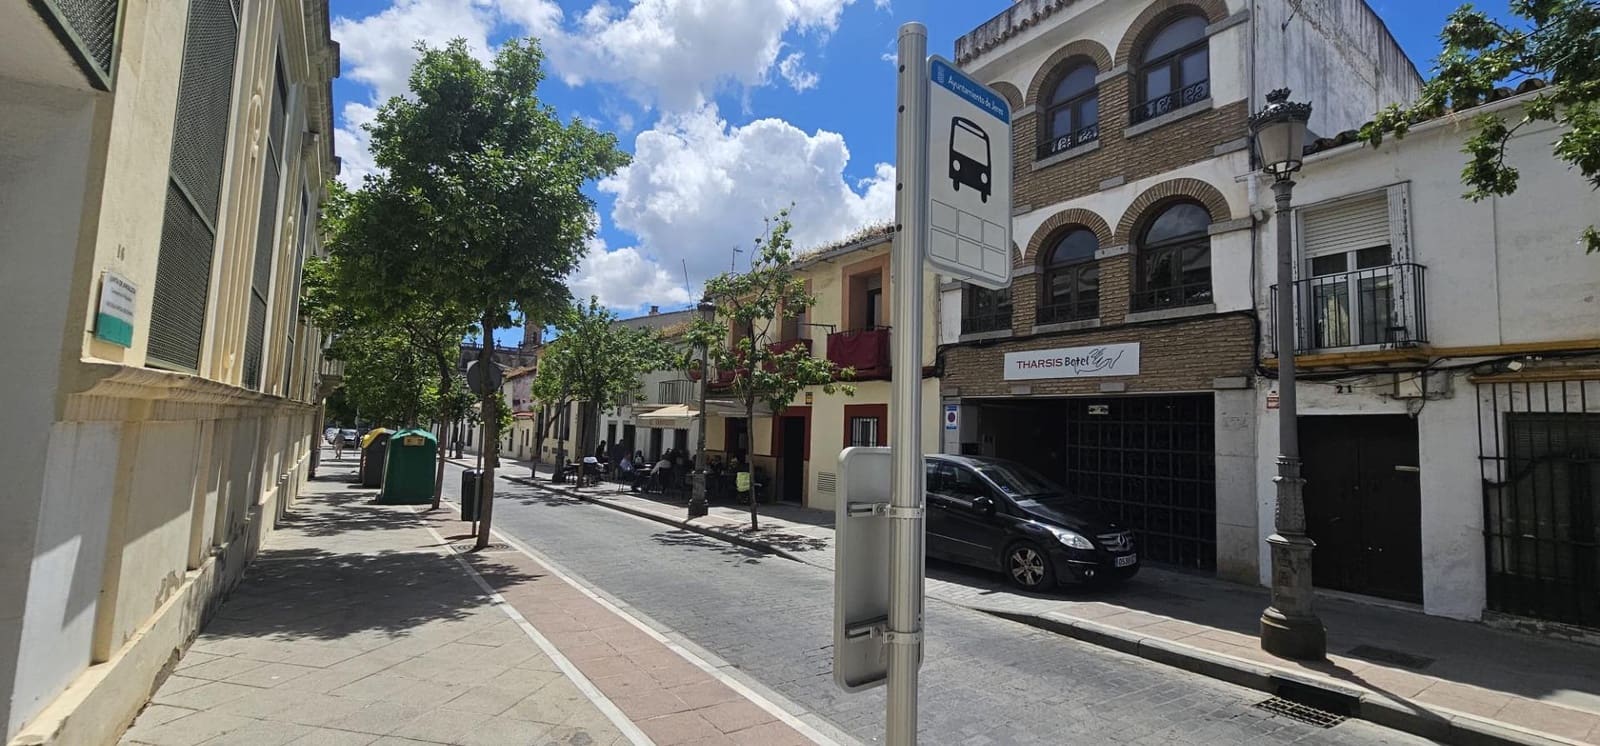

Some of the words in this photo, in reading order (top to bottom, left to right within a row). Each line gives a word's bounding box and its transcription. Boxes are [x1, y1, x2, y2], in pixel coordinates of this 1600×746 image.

[948, 75, 985, 106] Ayuntamiento
[985, 97, 992, 109] de
[1016, 358, 1063, 369] THARSIS
[1064, 356, 1090, 367] Botel
[1336, 385, 1353, 394] 21
